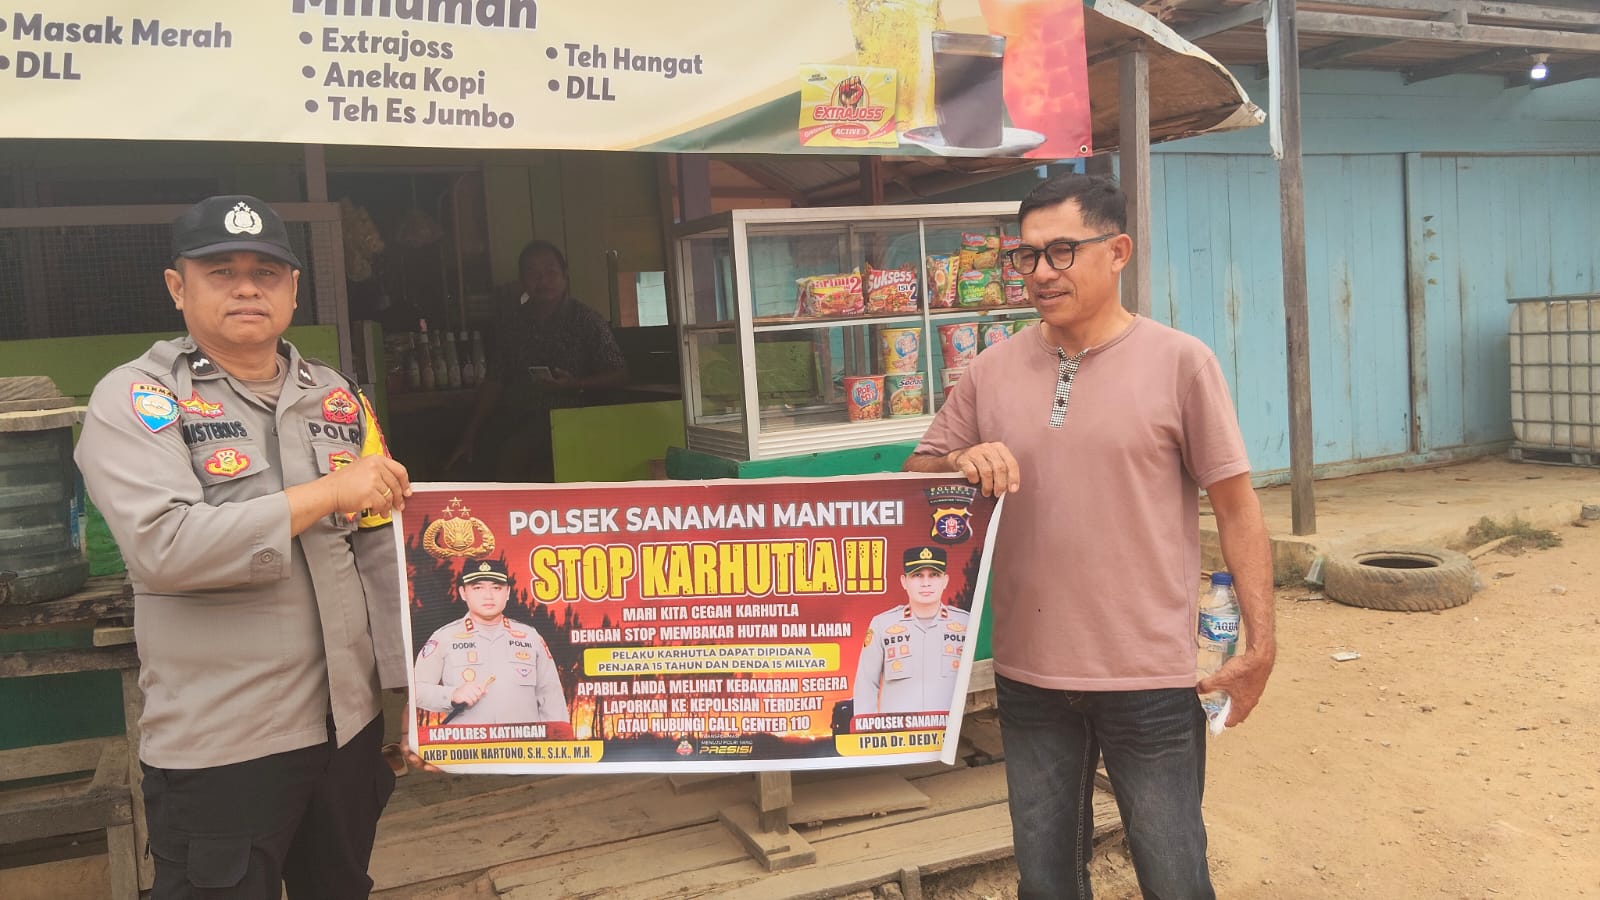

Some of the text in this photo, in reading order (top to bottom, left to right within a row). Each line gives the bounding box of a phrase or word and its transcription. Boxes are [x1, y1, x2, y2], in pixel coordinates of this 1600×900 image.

[12, 12, 233, 49] Masak Merah
[321, 27, 454, 62] Extrajoss
[15, 50, 82, 80] DLL
[564, 43, 703, 79] Teh Hangat
[324, 62, 486, 99] Aneka Kopi
[566, 75, 616, 101] DLL
[328, 95, 515, 129] Teh Es Jumbo
[813, 105, 884, 120] EXTRAJOSS
[308, 422, 360, 446] POLR
[509, 500, 904, 536] POLSEK SANAMAN MANTIKEI
[531, 545, 636, 602] STOP
[641, 540, 839, 598] KARHUTLA
[623, 603, 799, 622] MARI KITA CEGAH KARHUTLA
[571, 623, 851, 643] DENGAN STOP MEMBAKAR HUTAN DAN LAHAN
[1214, 621, 1239, 632] AQUA
[452, 642, 477, 650] DODIK
[884, 634, 911, 646] DEDY
[944, 633, 966, 643] POLR
[612, 647, 811, 660] PELAKU KARHUTLA DAPAT DIPIDANA
[598, 659, 826, 672] PENJARA 15 TAHUN DAN DENDA 15 MILYAR
[577, 676, 848, 696] APABILA ANDA MELIHAT KEBAKARAN SEGERA
[603, 696, 823, 714] LAPORKAN KE KEPOLISIAN TERDEKAT
[617, 716, 810, 733] ATAU HUBUNGI CALL CENTER 110
[855, 716, 904, 730] KAPOLSEK
[429, 725, 547, 741] KAPOLRES KATINGAN
[860, 736, 888, 749] IPDA
[890, 735, 906, 747] Dr.
[423, 749, 448, 761] AKBP
[450, 749, 479, 760] DODIK
[699, 745, 753, 754] PRESISI
